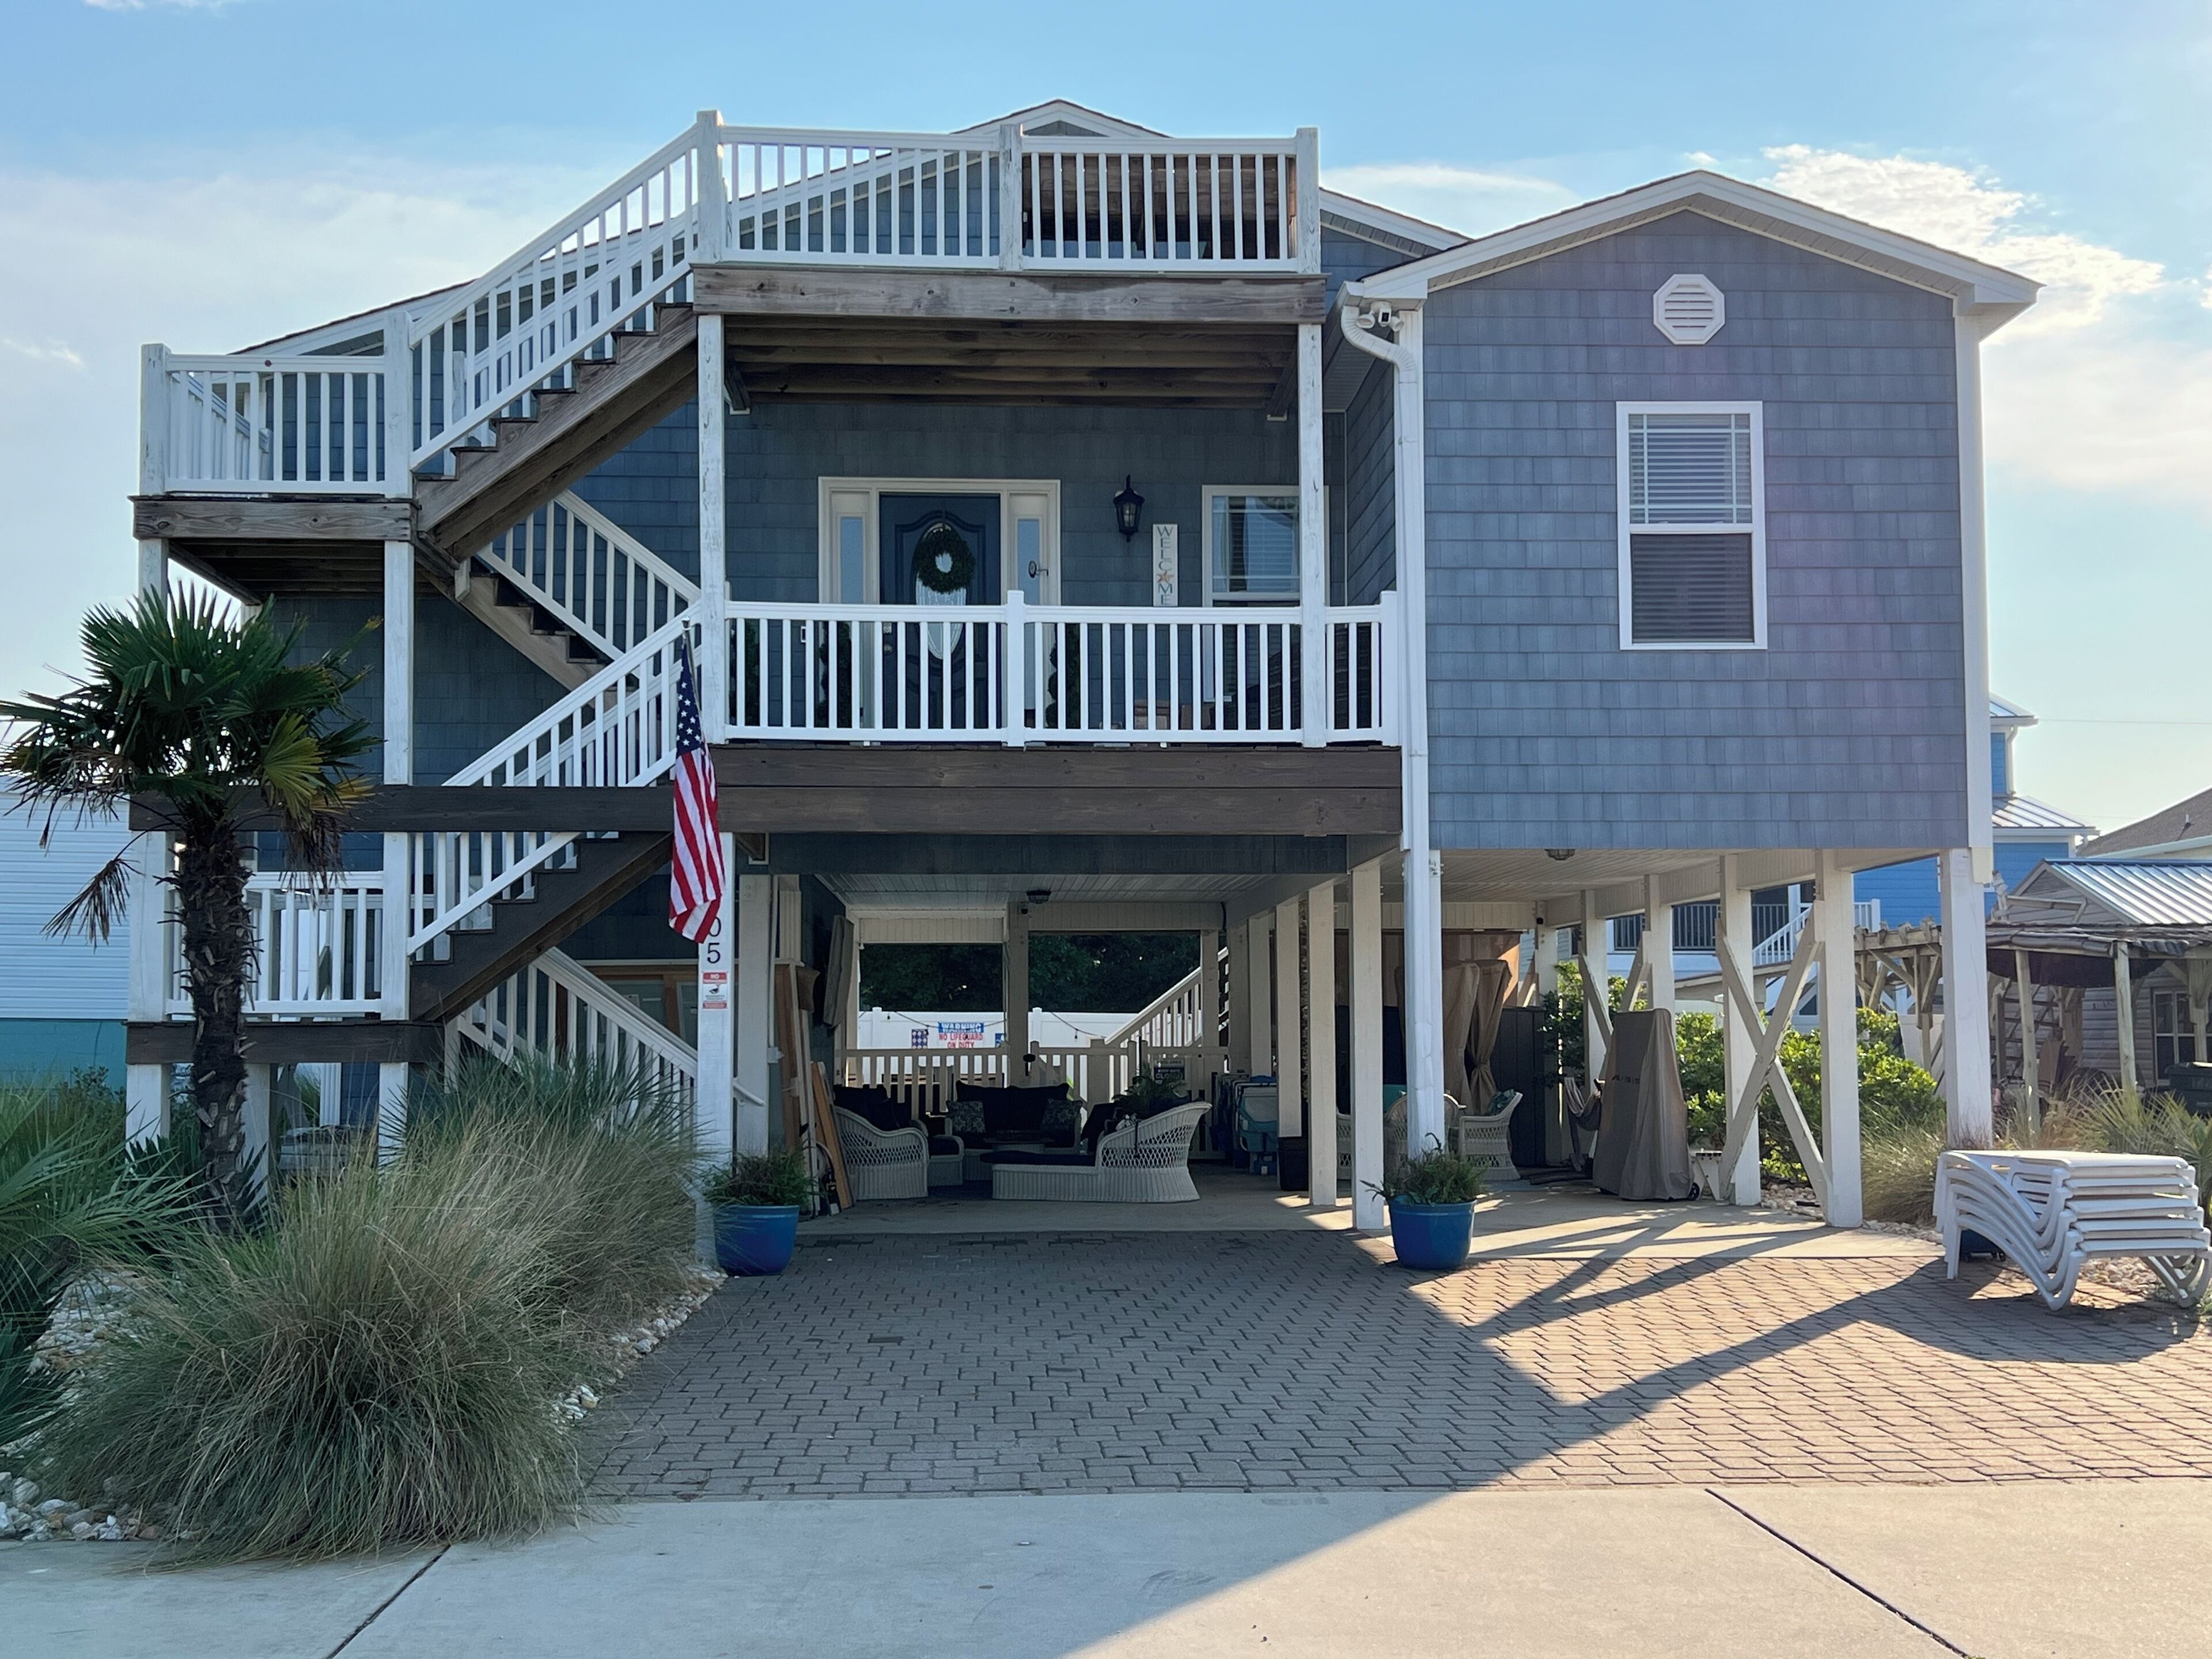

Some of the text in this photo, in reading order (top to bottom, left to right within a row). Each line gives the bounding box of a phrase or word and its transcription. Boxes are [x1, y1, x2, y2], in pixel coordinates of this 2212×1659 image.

[1157, 526, 1173, 605] WELCME
[941, 1023, 982, 1033] WARNING
[950, 1033, 983, 1041] LIFEGUARD
